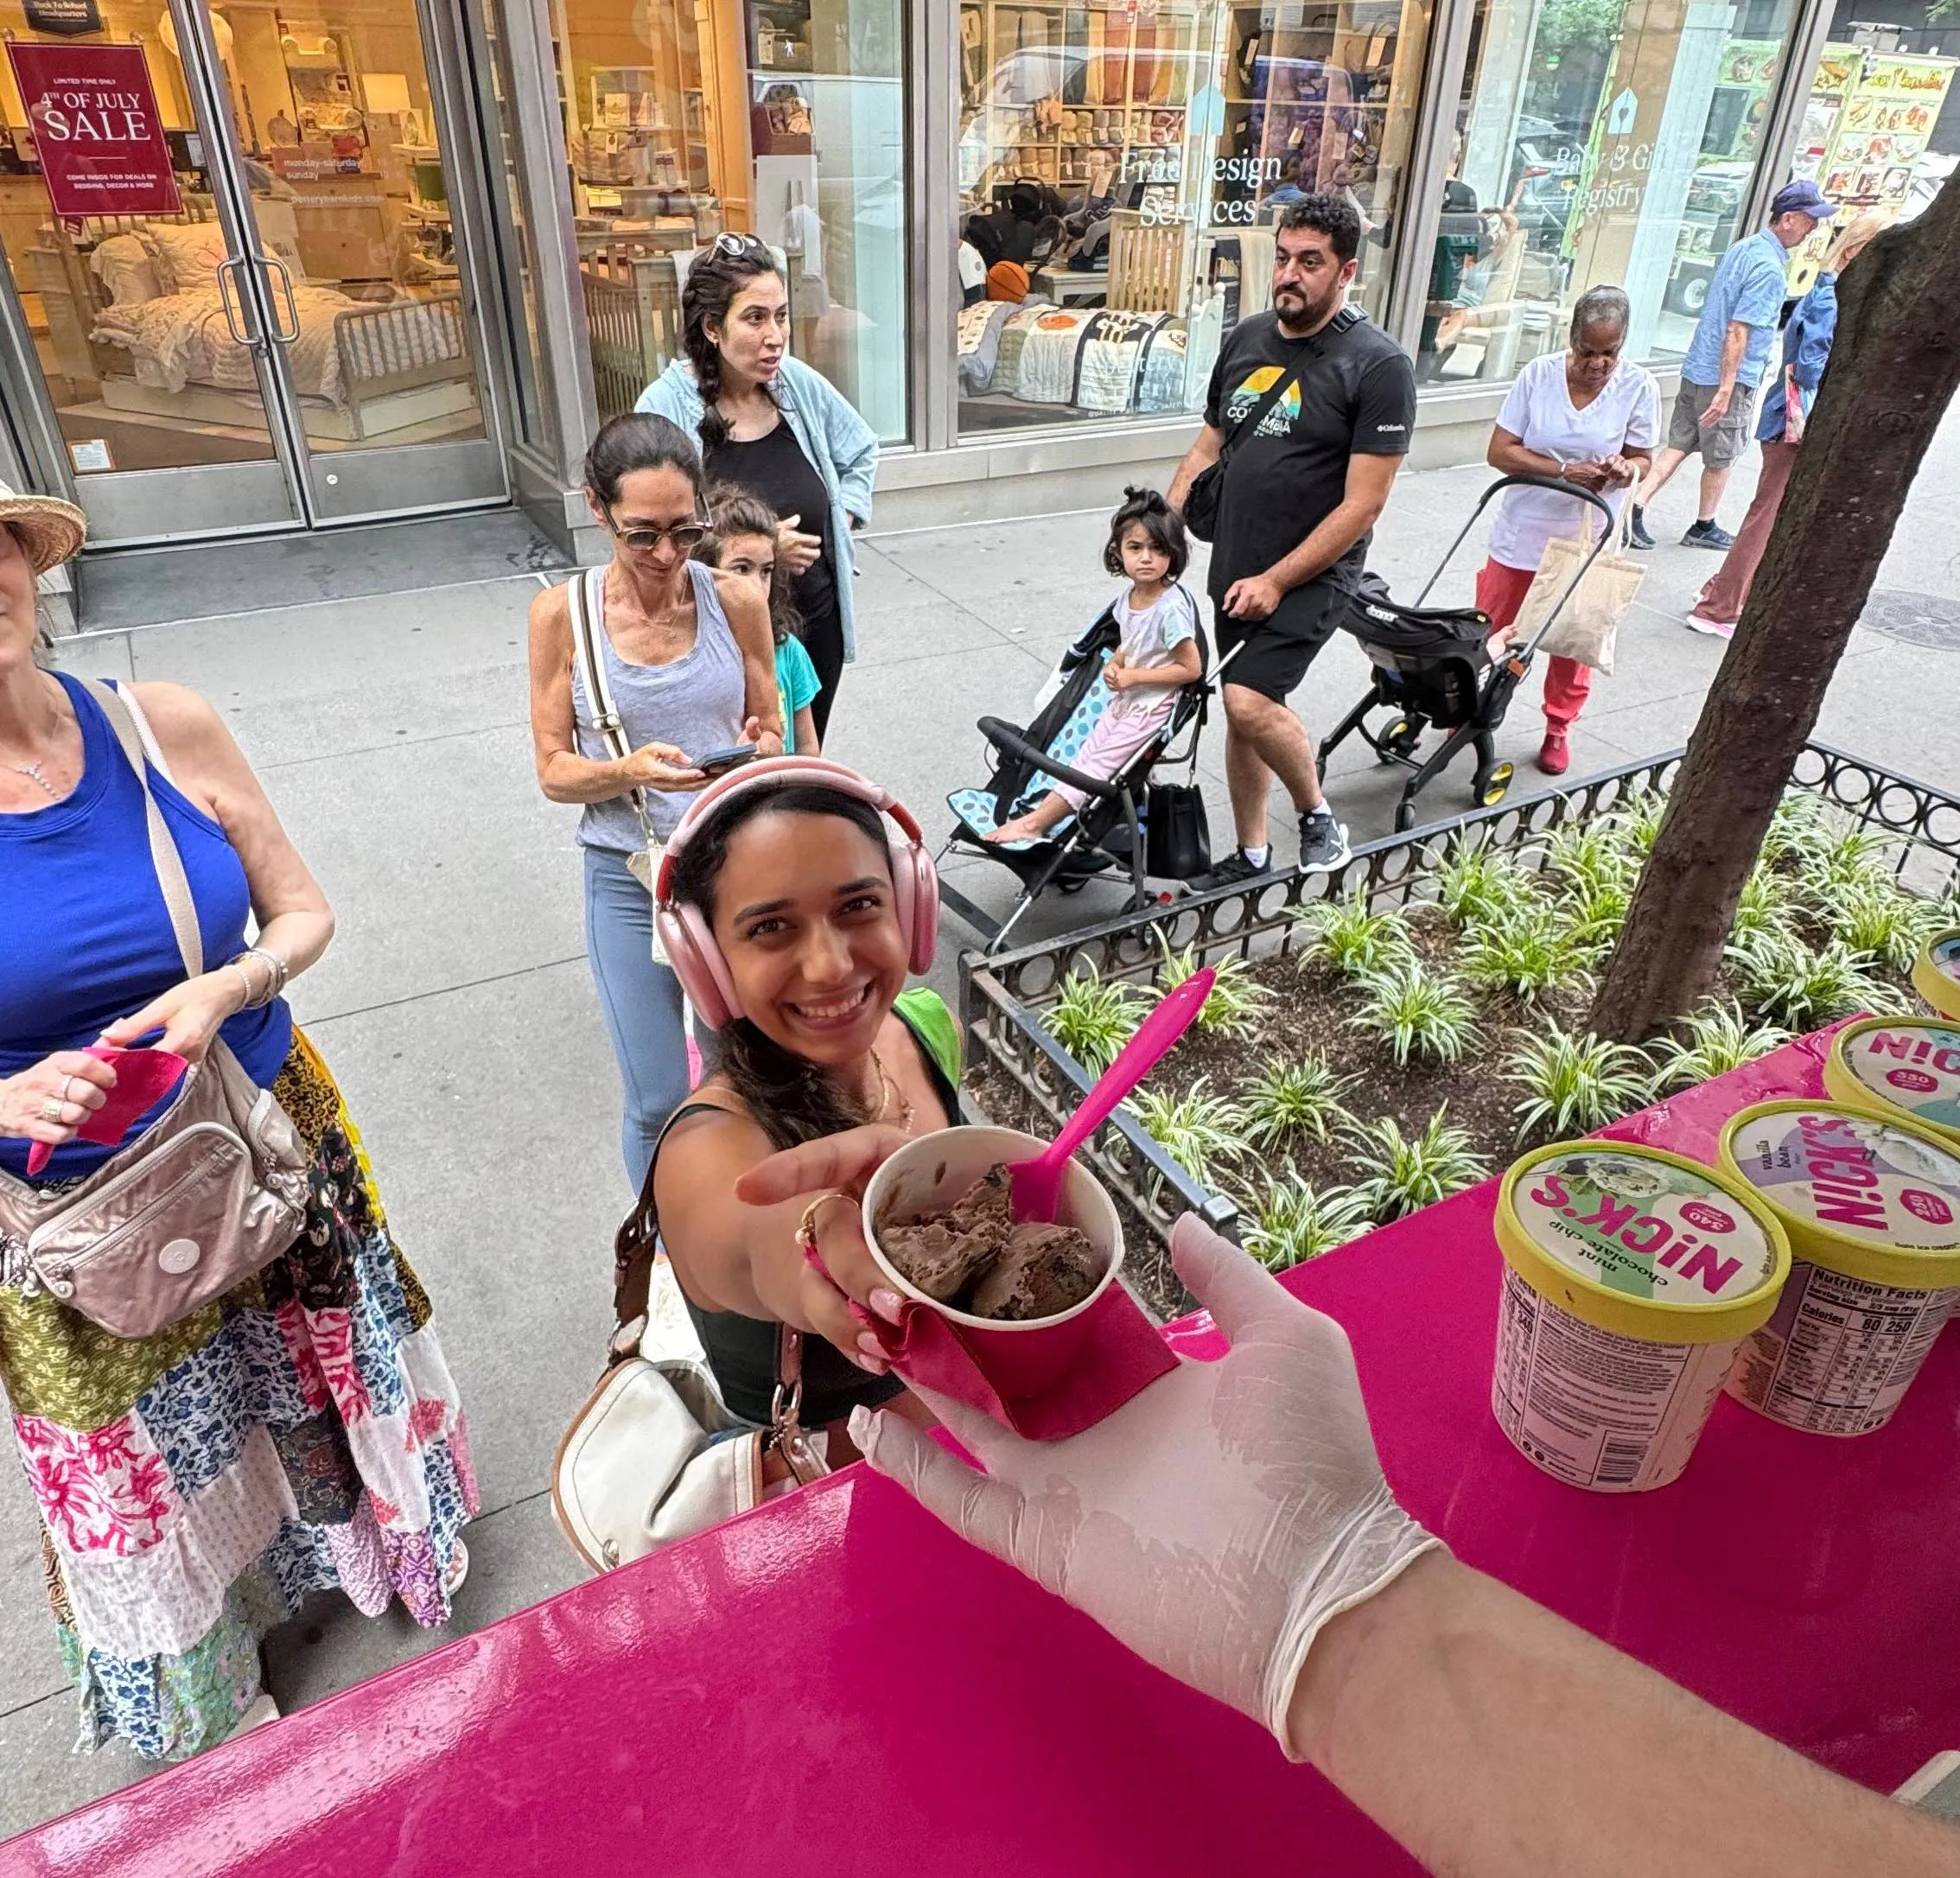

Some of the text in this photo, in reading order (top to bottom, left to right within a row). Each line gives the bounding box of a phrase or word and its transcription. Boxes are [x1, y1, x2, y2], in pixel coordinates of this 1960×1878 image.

[41, 92, 141, 109] 4TH OF JULY
[44, 110, 151, 141] SALE
[1118, 152, 1180, 184] Free
[1556, 146, 1609, 174] Bay
[287, 171, 319, 181] sunday
[1140, 195, 1257, 226] Serces
[1563, 184, 1640, 215] gistry
[1227, 406, 1291, 434] COMBIA
[1756, 1140, 1773, 1170] vanilla
[1777, 1146, 1791, 1168] bean
[1549, 1221, 1669, 1287] chocolate chip
[1577, 1247, 1619, 1273] mint
[1814, 1269, 1882, 1296] Nutrition
[1886, 1288, 1928, 1300] Facts
[1801, 1302, 1845, 1325] Calories
[1861, 1318, 1912, 1333] 80 250
